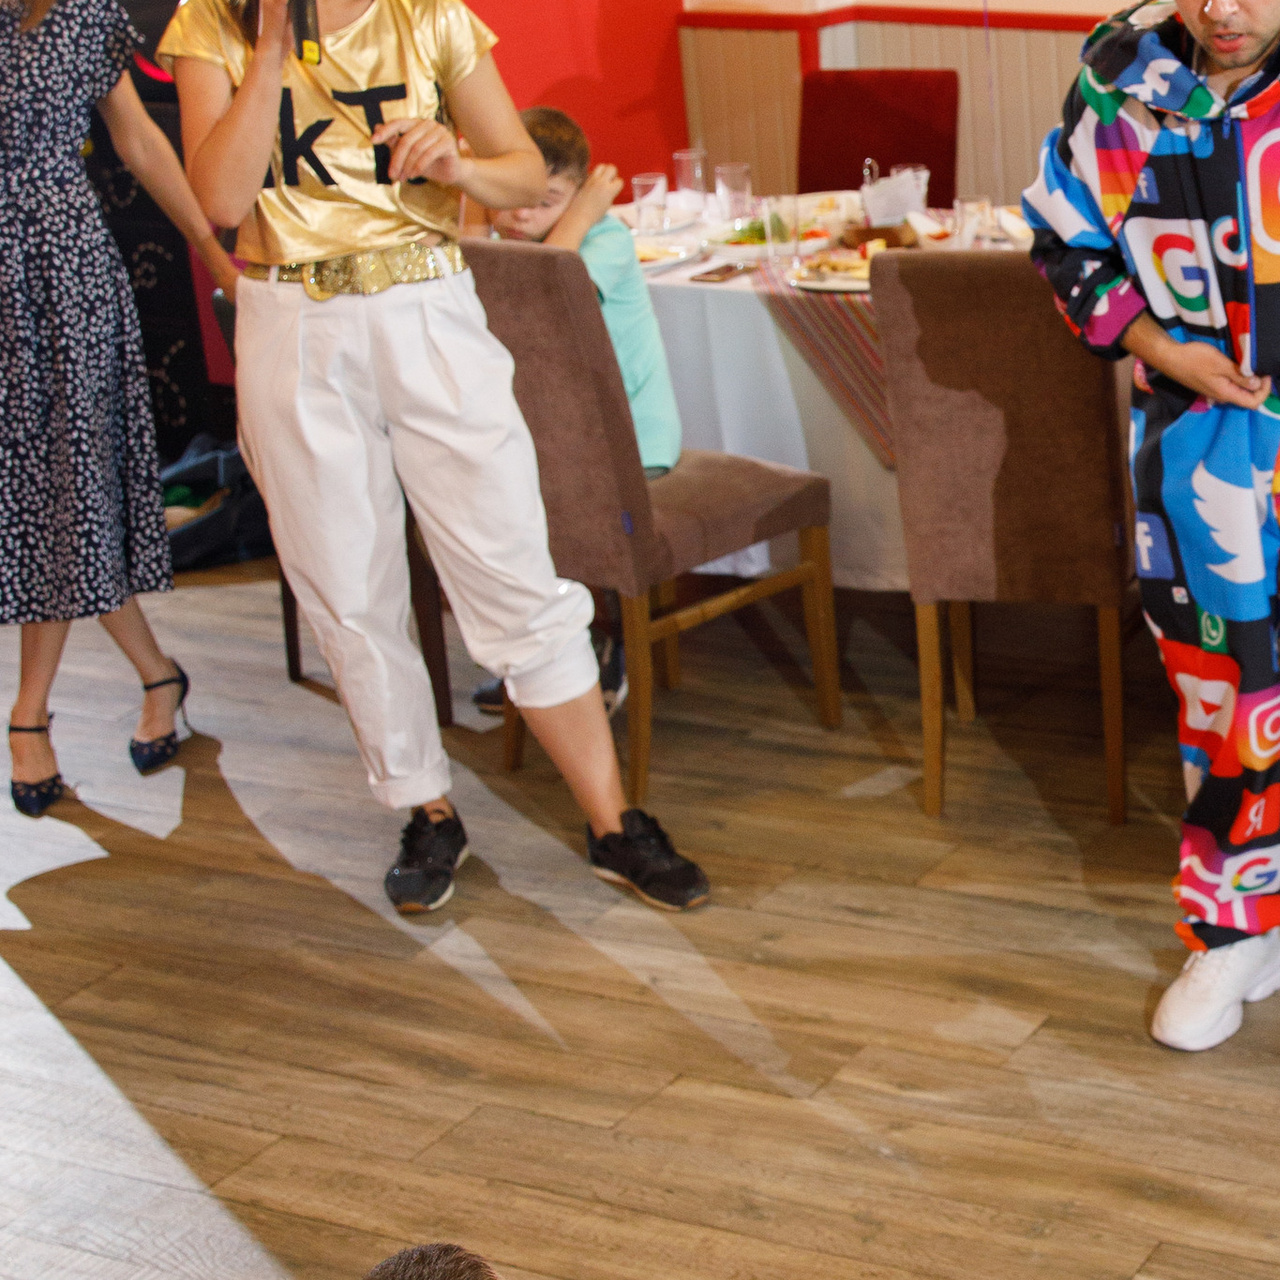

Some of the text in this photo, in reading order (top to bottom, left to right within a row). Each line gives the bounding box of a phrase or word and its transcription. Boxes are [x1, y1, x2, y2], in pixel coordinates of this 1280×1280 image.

[1151, 232, 1211, 313] G
[1135, 521, 1154, 572] f
[1244, 796, 1267, 838] Я
[1230, 856, 1273, 893] G
